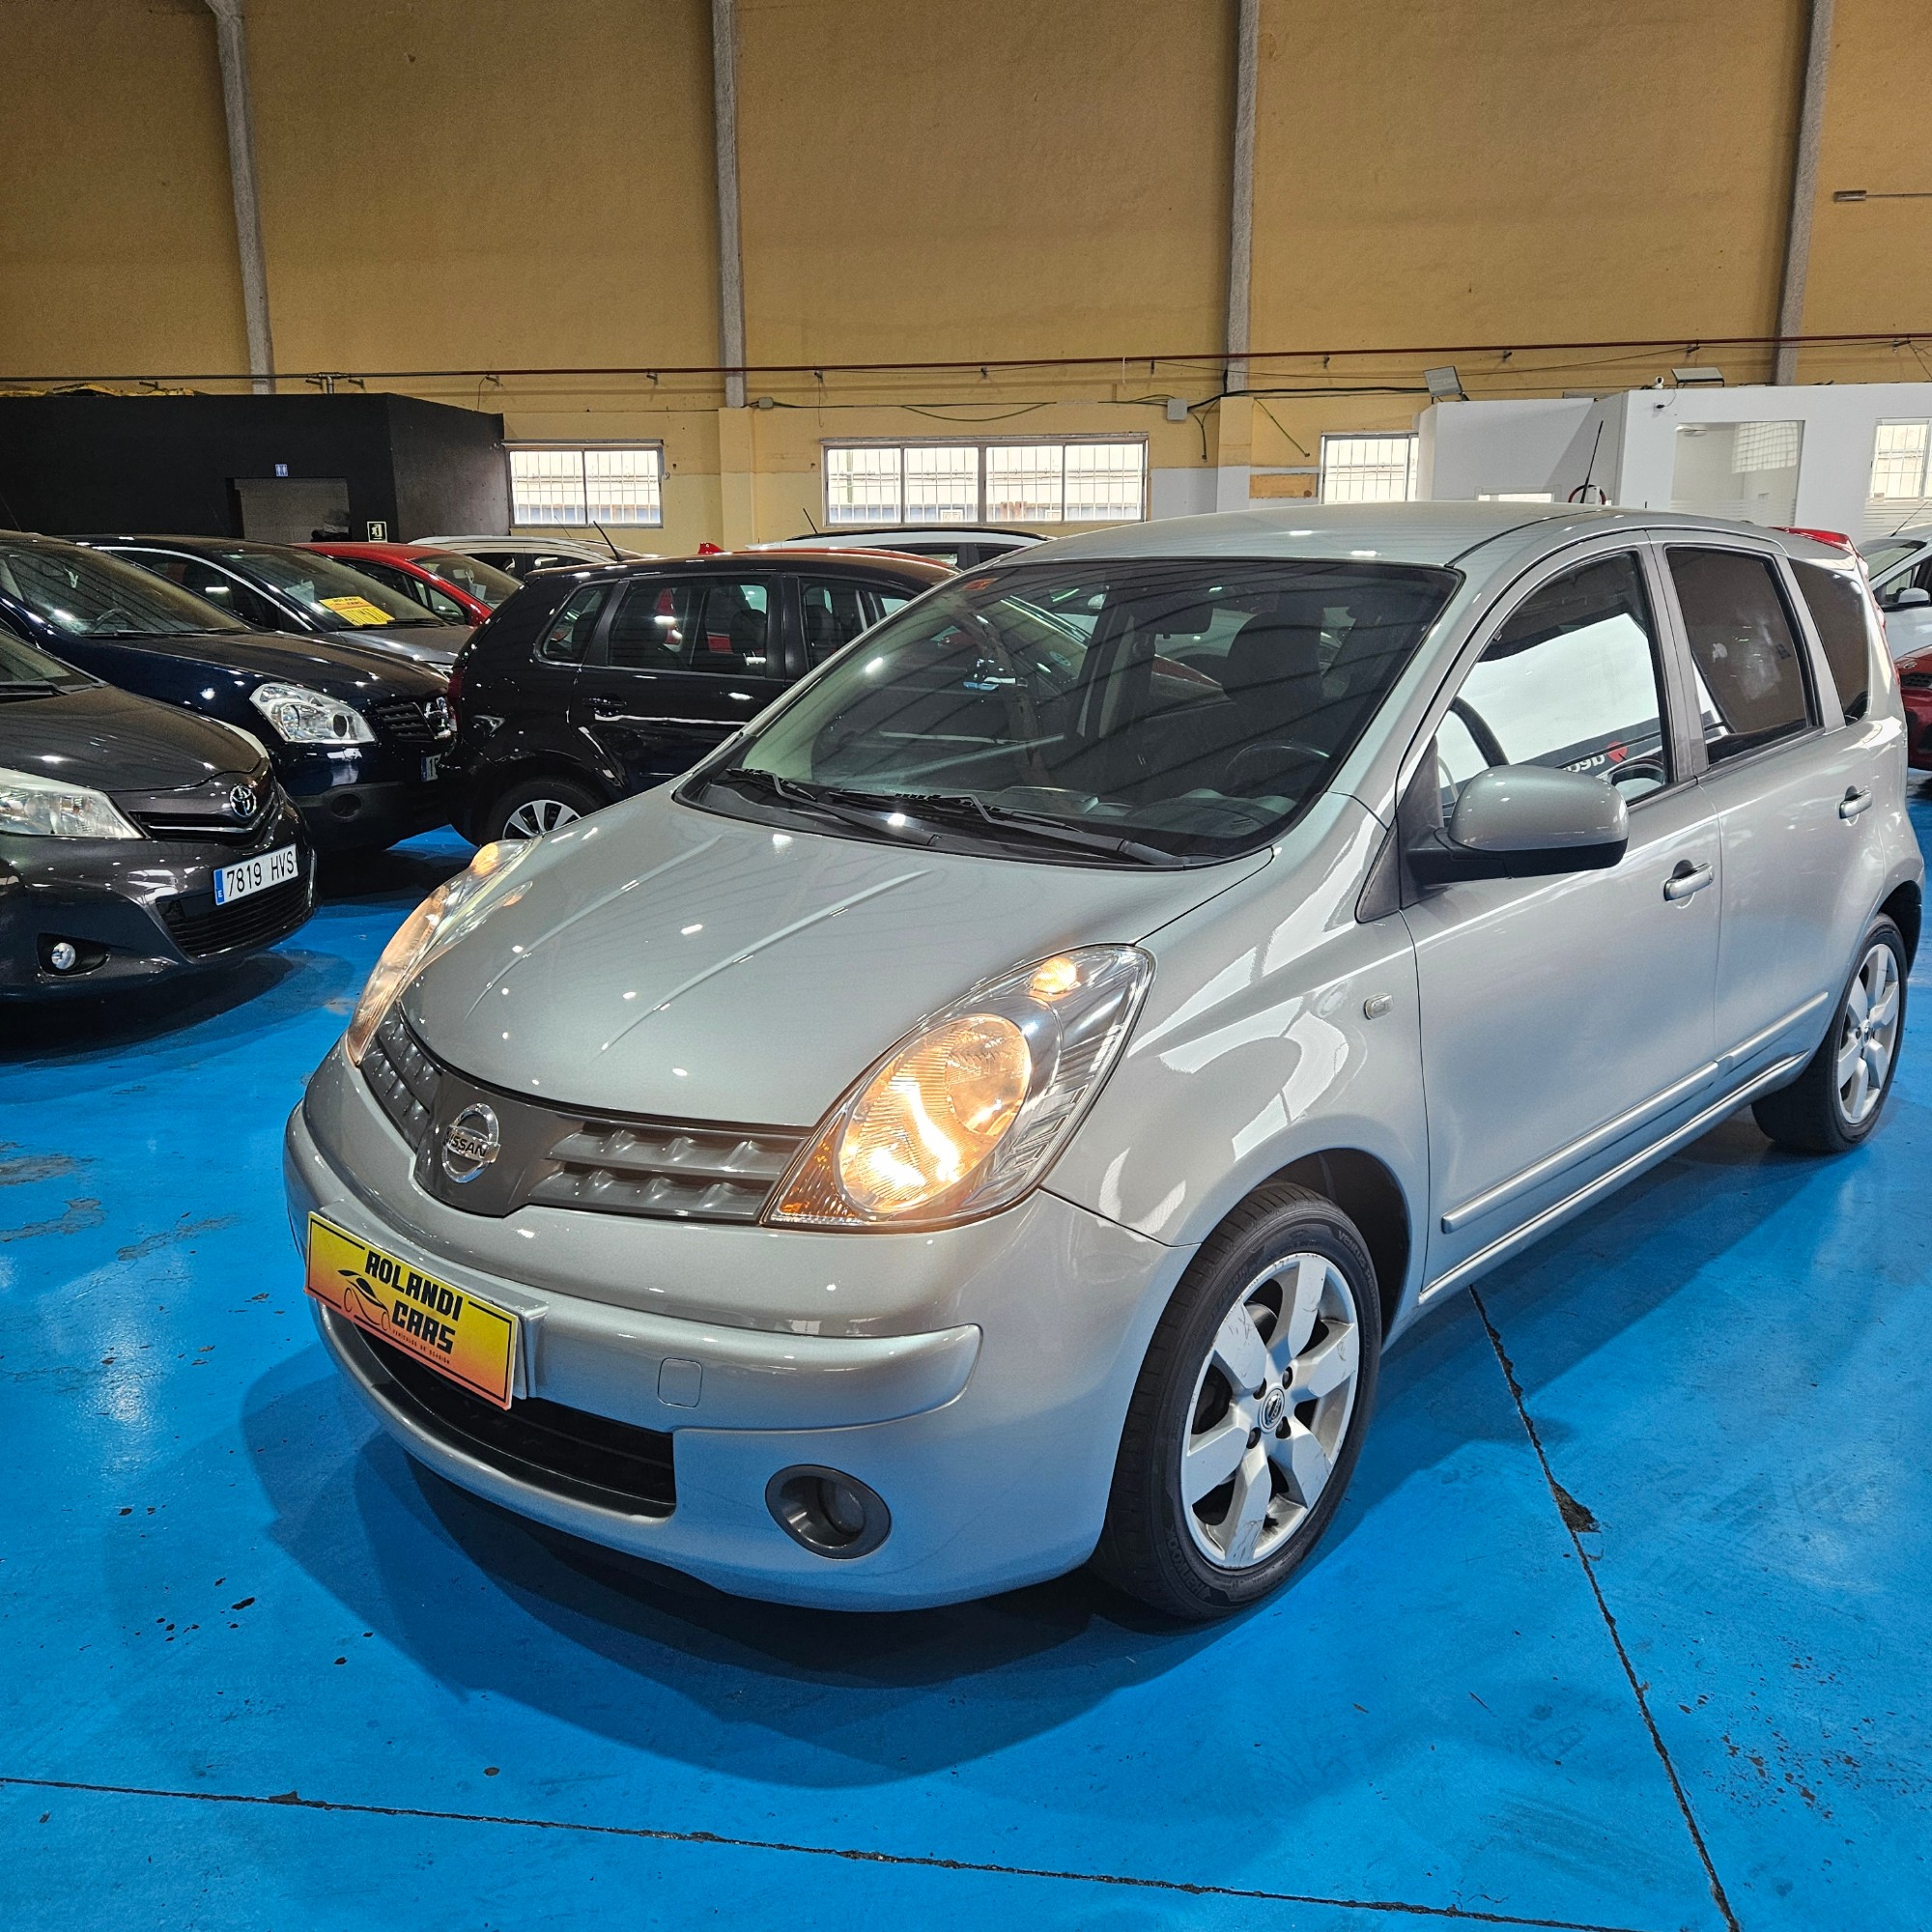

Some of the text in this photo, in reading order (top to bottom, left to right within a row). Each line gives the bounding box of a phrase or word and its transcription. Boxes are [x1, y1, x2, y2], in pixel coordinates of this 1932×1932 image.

[226, 850, 295, 897] 7819 HVS
[364, 1249, 464, 1322] ROLANDI
[391, 1299, 456, 1355] CARS
